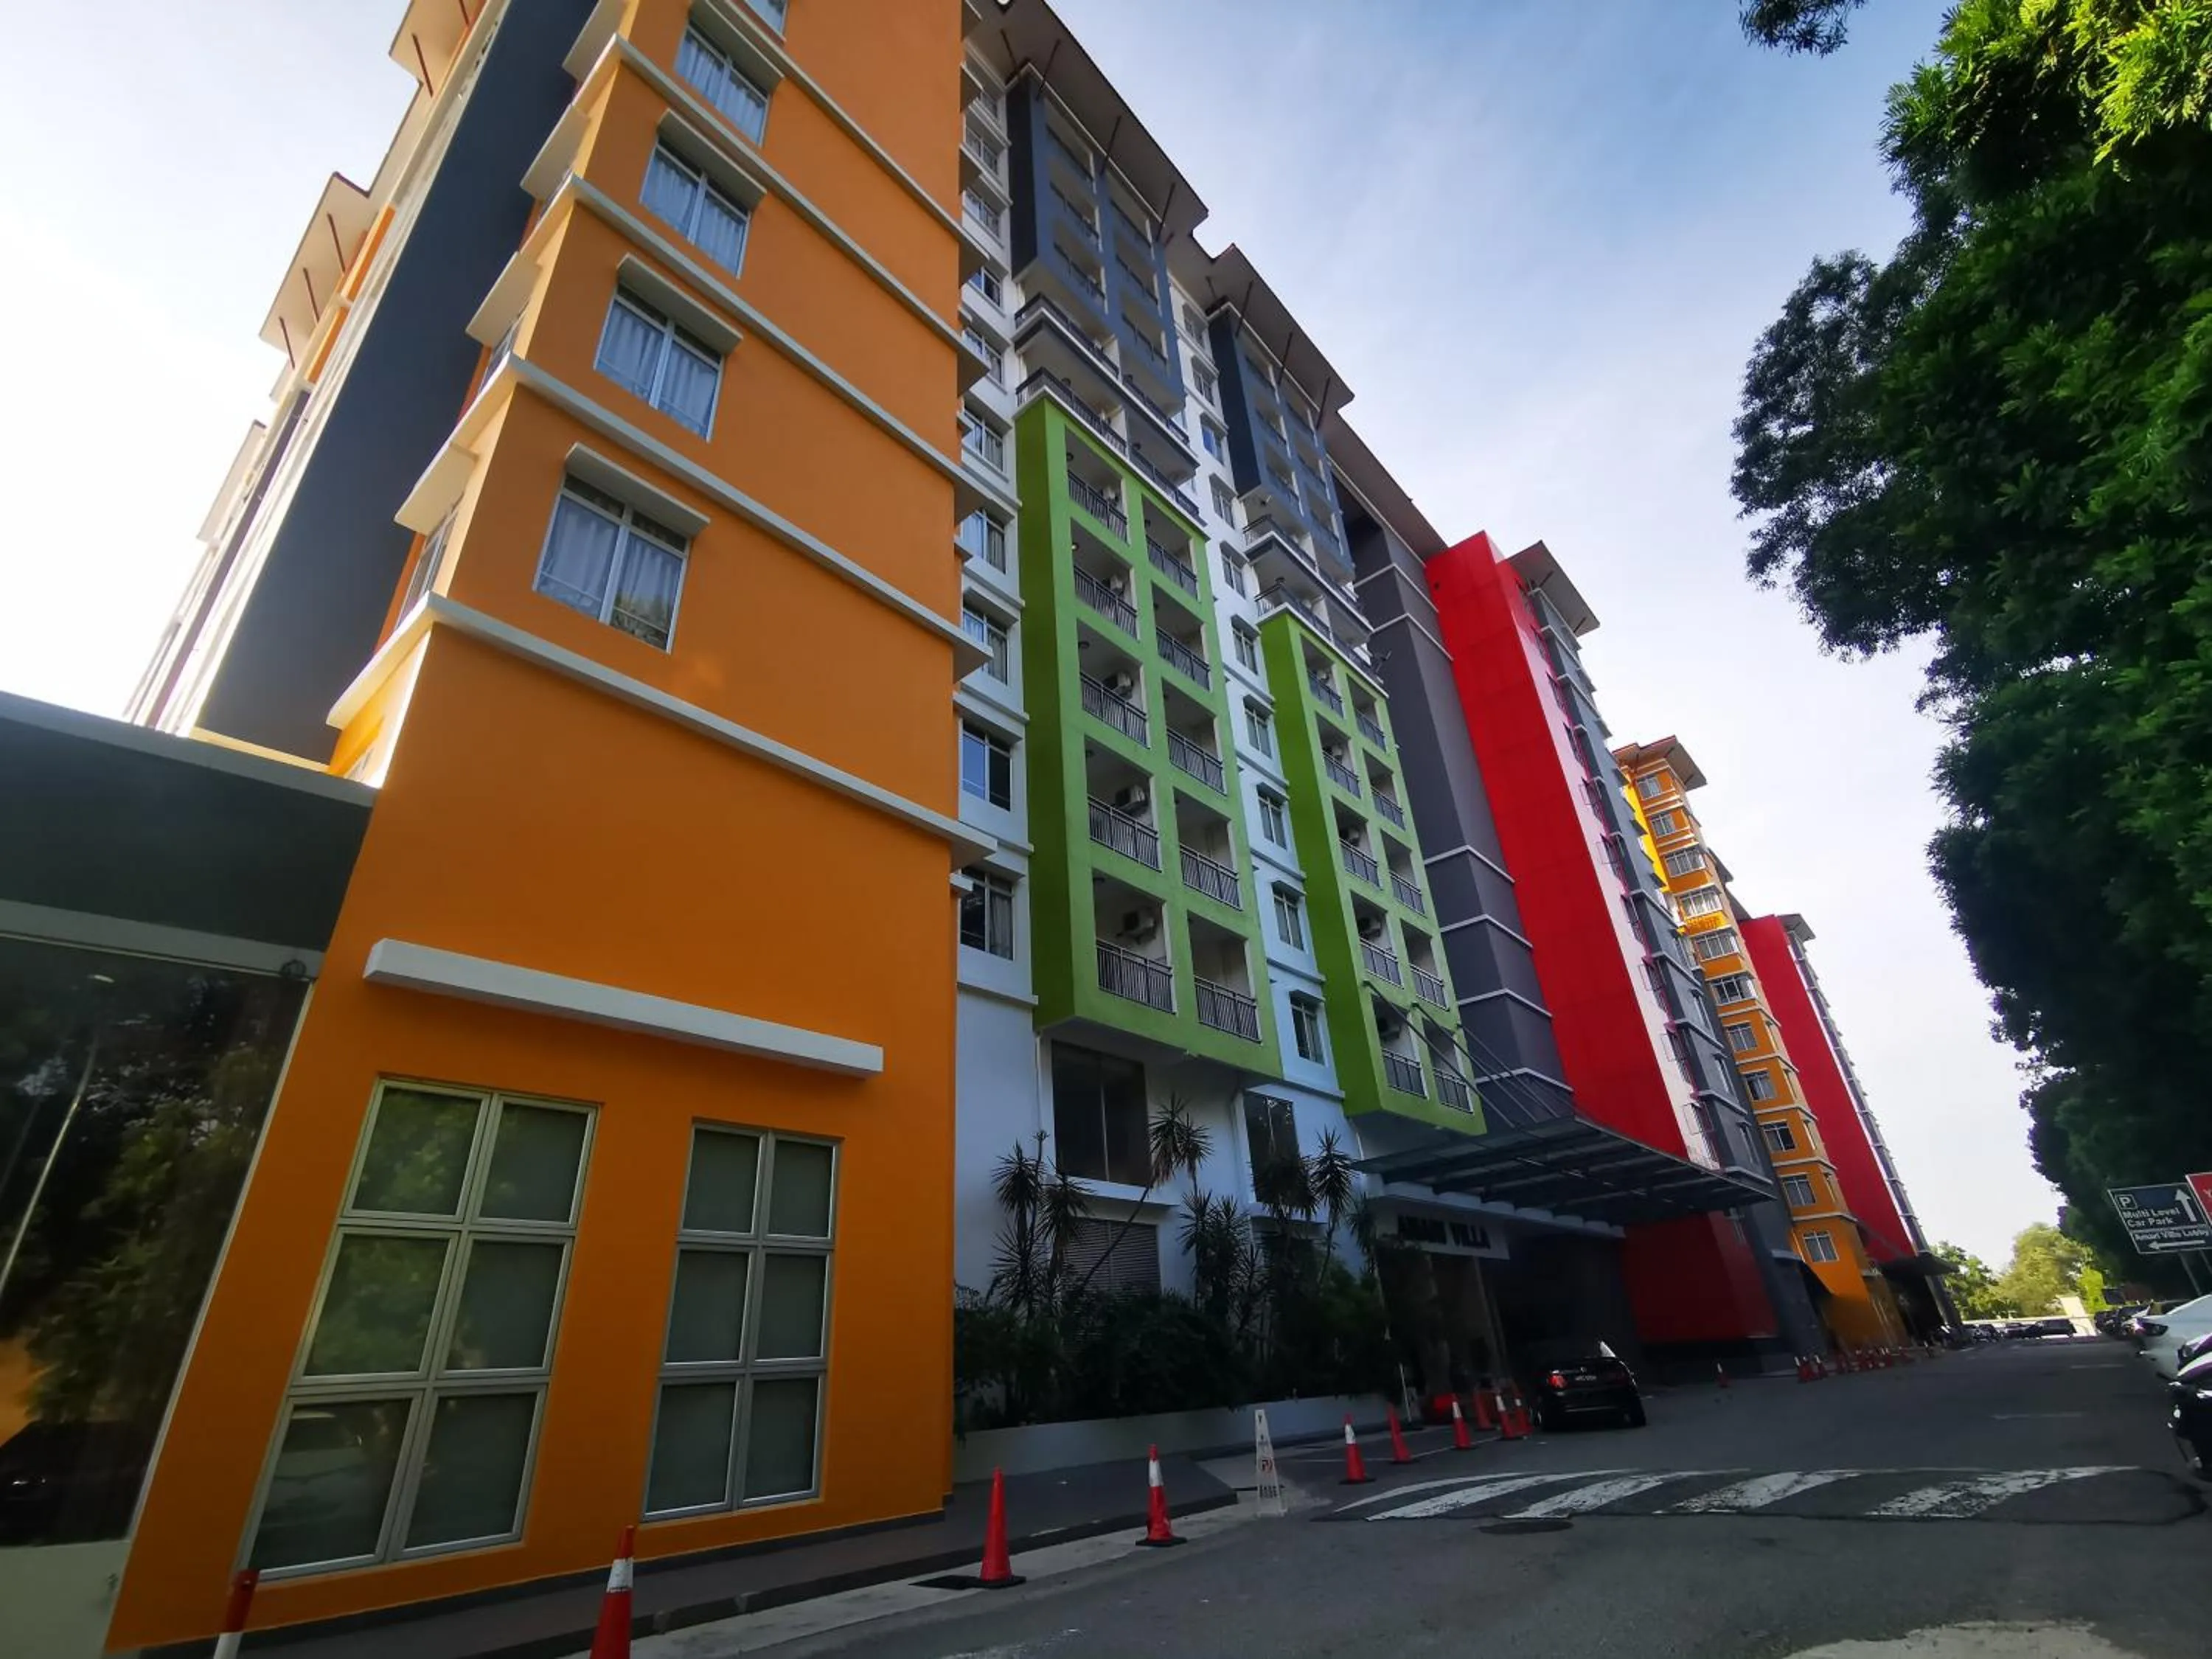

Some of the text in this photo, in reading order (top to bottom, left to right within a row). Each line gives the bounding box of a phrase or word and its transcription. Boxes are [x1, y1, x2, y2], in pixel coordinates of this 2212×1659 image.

[2151, 1207, 2180, 1216] Level
[2127, 1217, 2174, 1227] Car Park
[1448, 1222, 1491, 1250] VILLA
